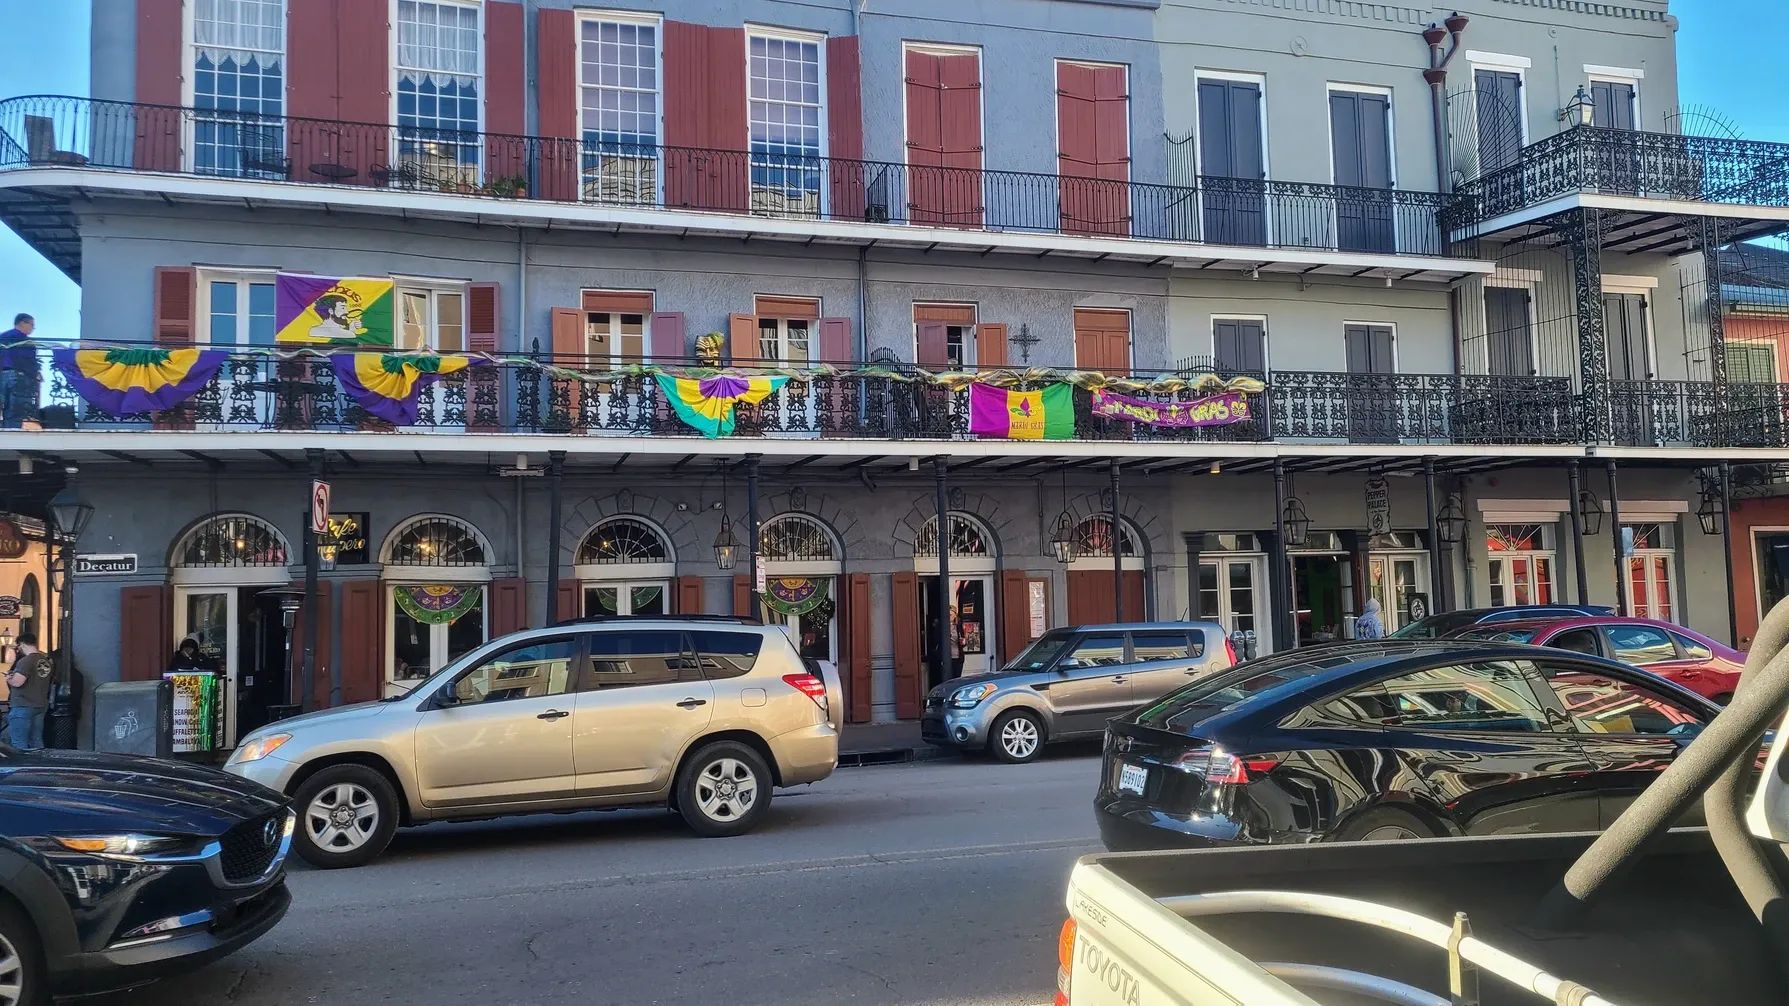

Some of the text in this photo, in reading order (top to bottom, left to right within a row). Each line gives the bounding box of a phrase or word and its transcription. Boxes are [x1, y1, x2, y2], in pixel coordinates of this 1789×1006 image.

[1367, 490, 1386, 500] PEPPER
[80, 561, 133, 571] Decatur
[1080, 934, 1140, 1006] TOYOTA
